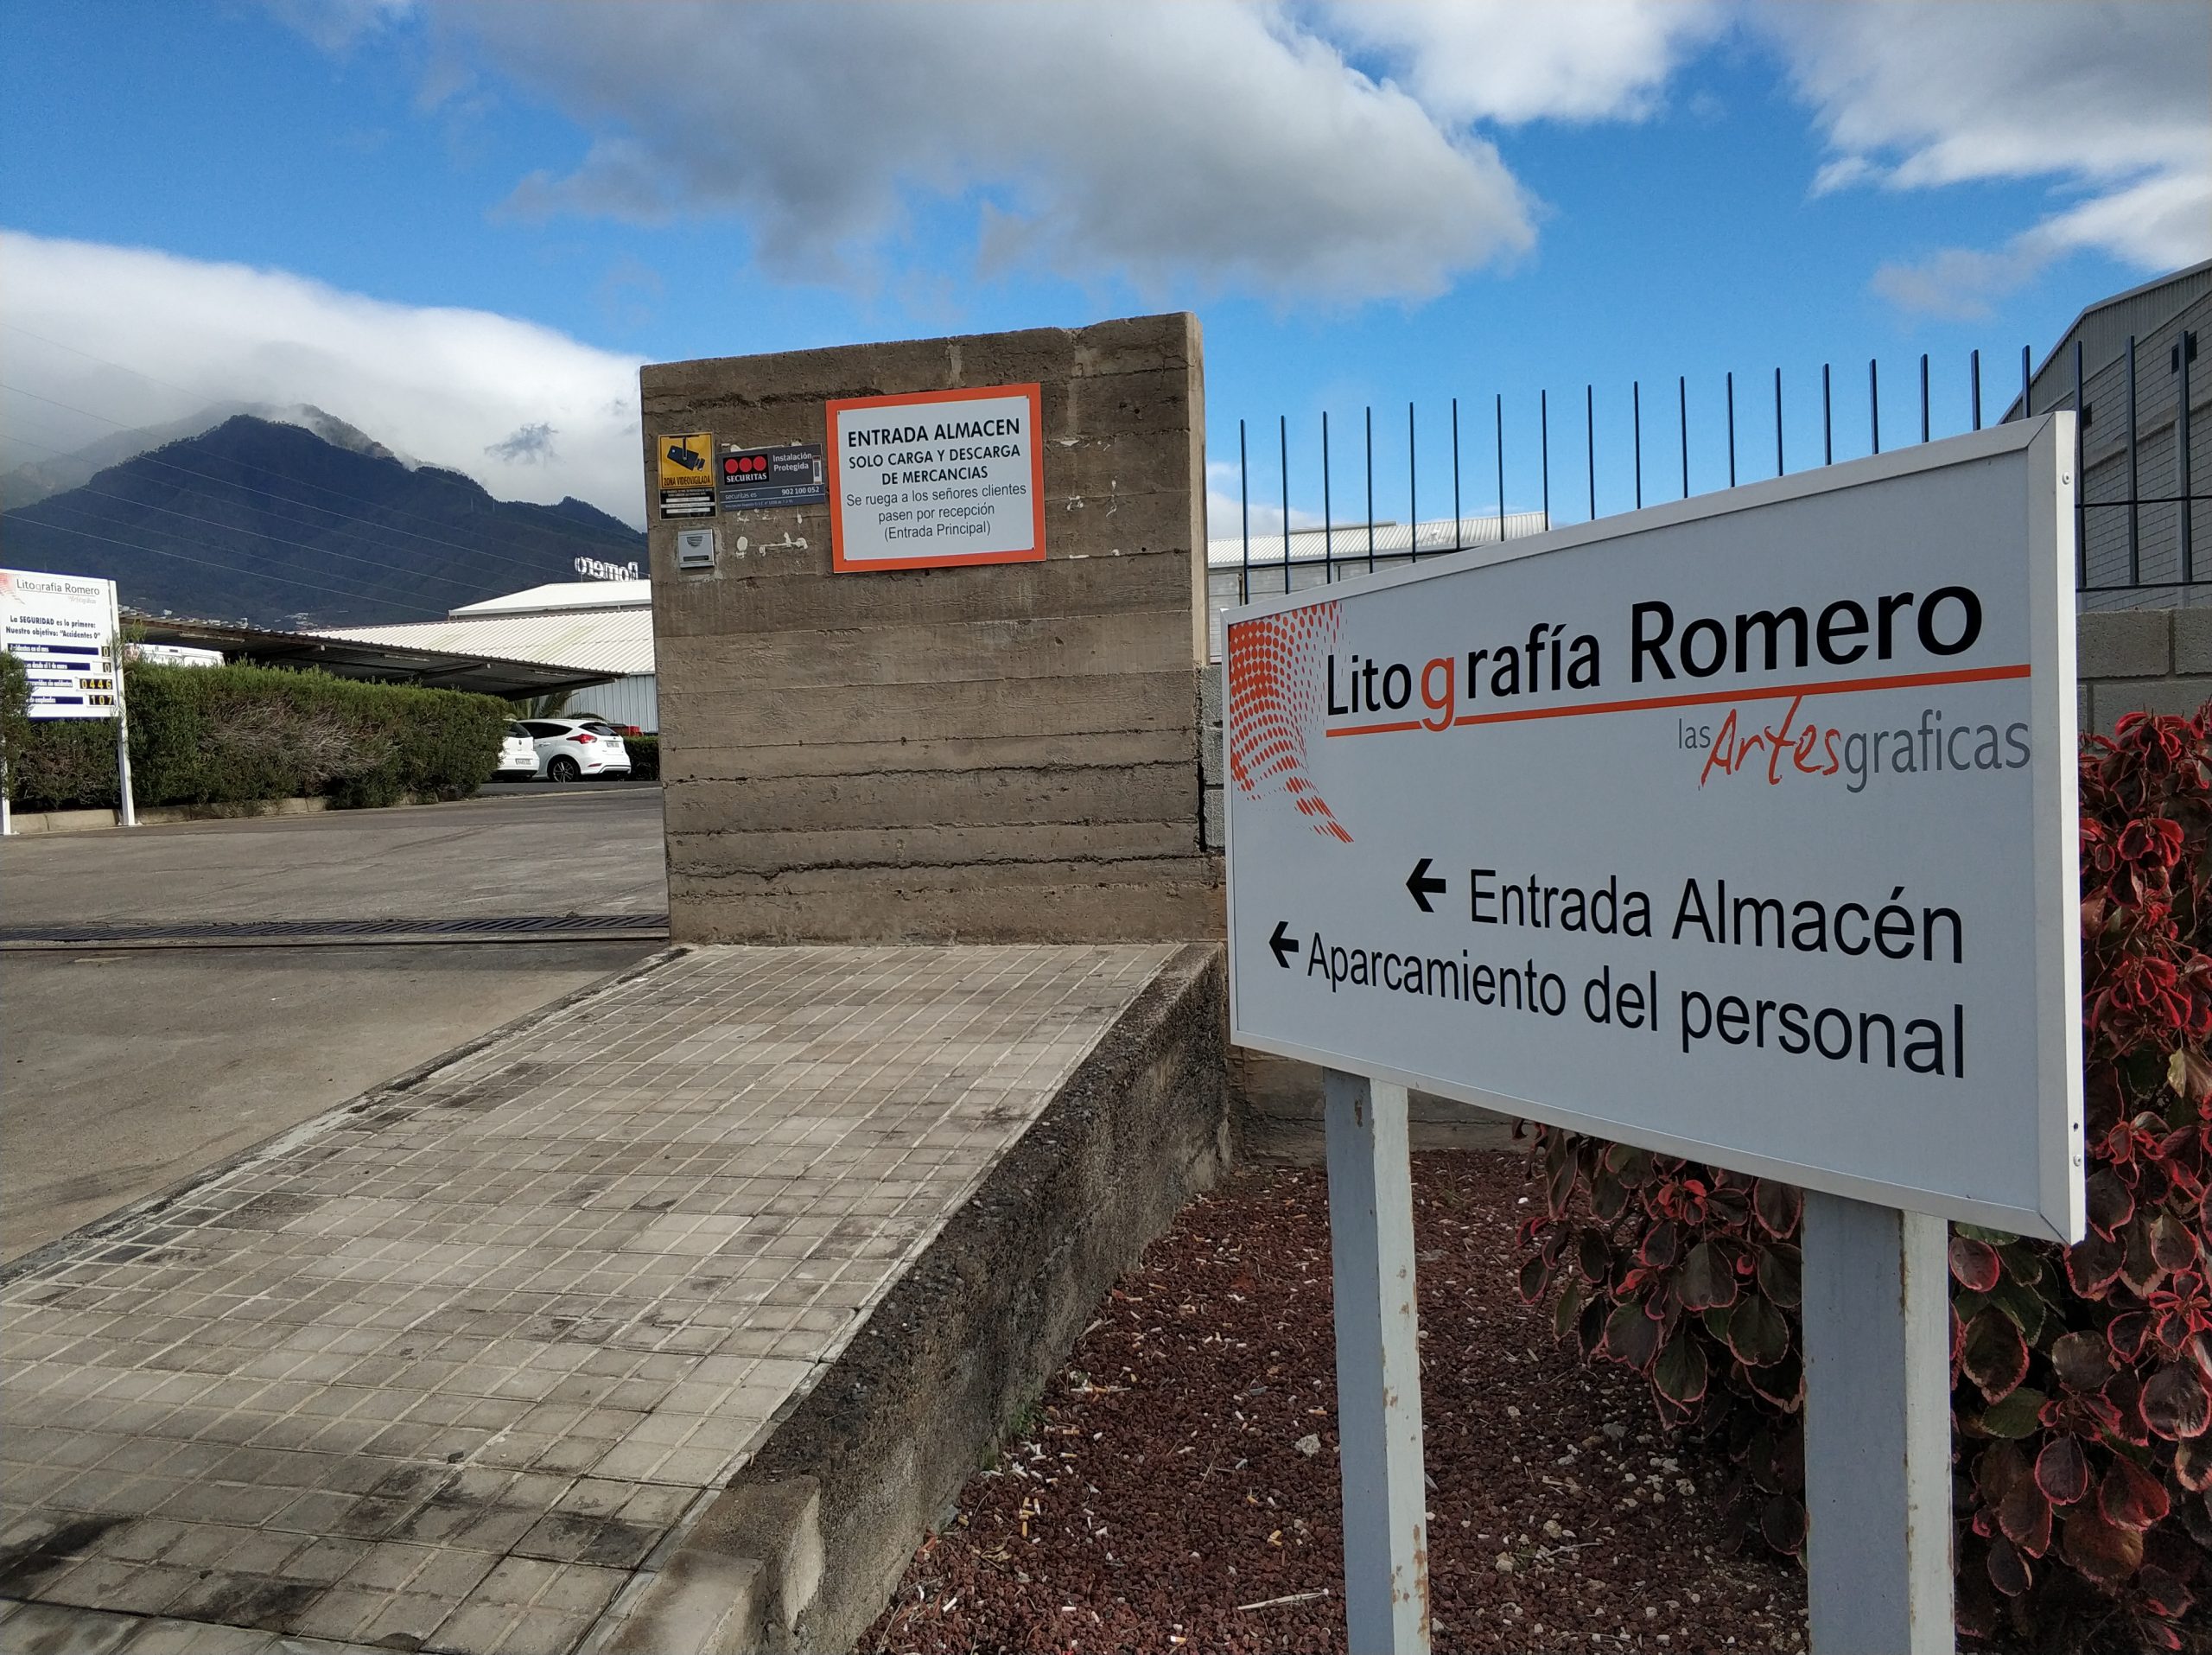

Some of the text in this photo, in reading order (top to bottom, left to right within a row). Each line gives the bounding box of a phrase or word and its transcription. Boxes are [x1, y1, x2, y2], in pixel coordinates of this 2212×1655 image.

[848, 418, 1020, 447] ENTRADA ALMACEN
[773, 452, 812, 462] Instalación
[849, 444, 1020, 468] SOLO CARGA Y DESCARGA
[774, 463, 809, 472] Protegida
[664, 474, 711, 486] ZONA VIDEOVIGILADA
[727, 474, 767, 483] SECURITAS
[882, 466, 988, 485] DE MERCANCIAS
[847, 483, 1027, 506] Se ruega a los señores clientes
[879, 502, 995, 525] pasen por recepción
[885, 520, 991, 542] (Entrada Principal)
[65, 583, 99, 595] Romero
[20, 616, 54, 625] SEGURIDAD
[72, 620, 96, 628] primero:
[33, 628, 58, 637] objetivo:
[104, 647, 108, 656] 0
[1326, 585, 1983, 732] Litografía Romero
[105, 664, 110, 672] 0
[92, 696, 112, 704] 107
[1678, 718, 1711, 750] las
[1471, 869, 1962, 963] Entrada Almacén
[1306, 932, 1964, 1078] Aparcamiento del personal
